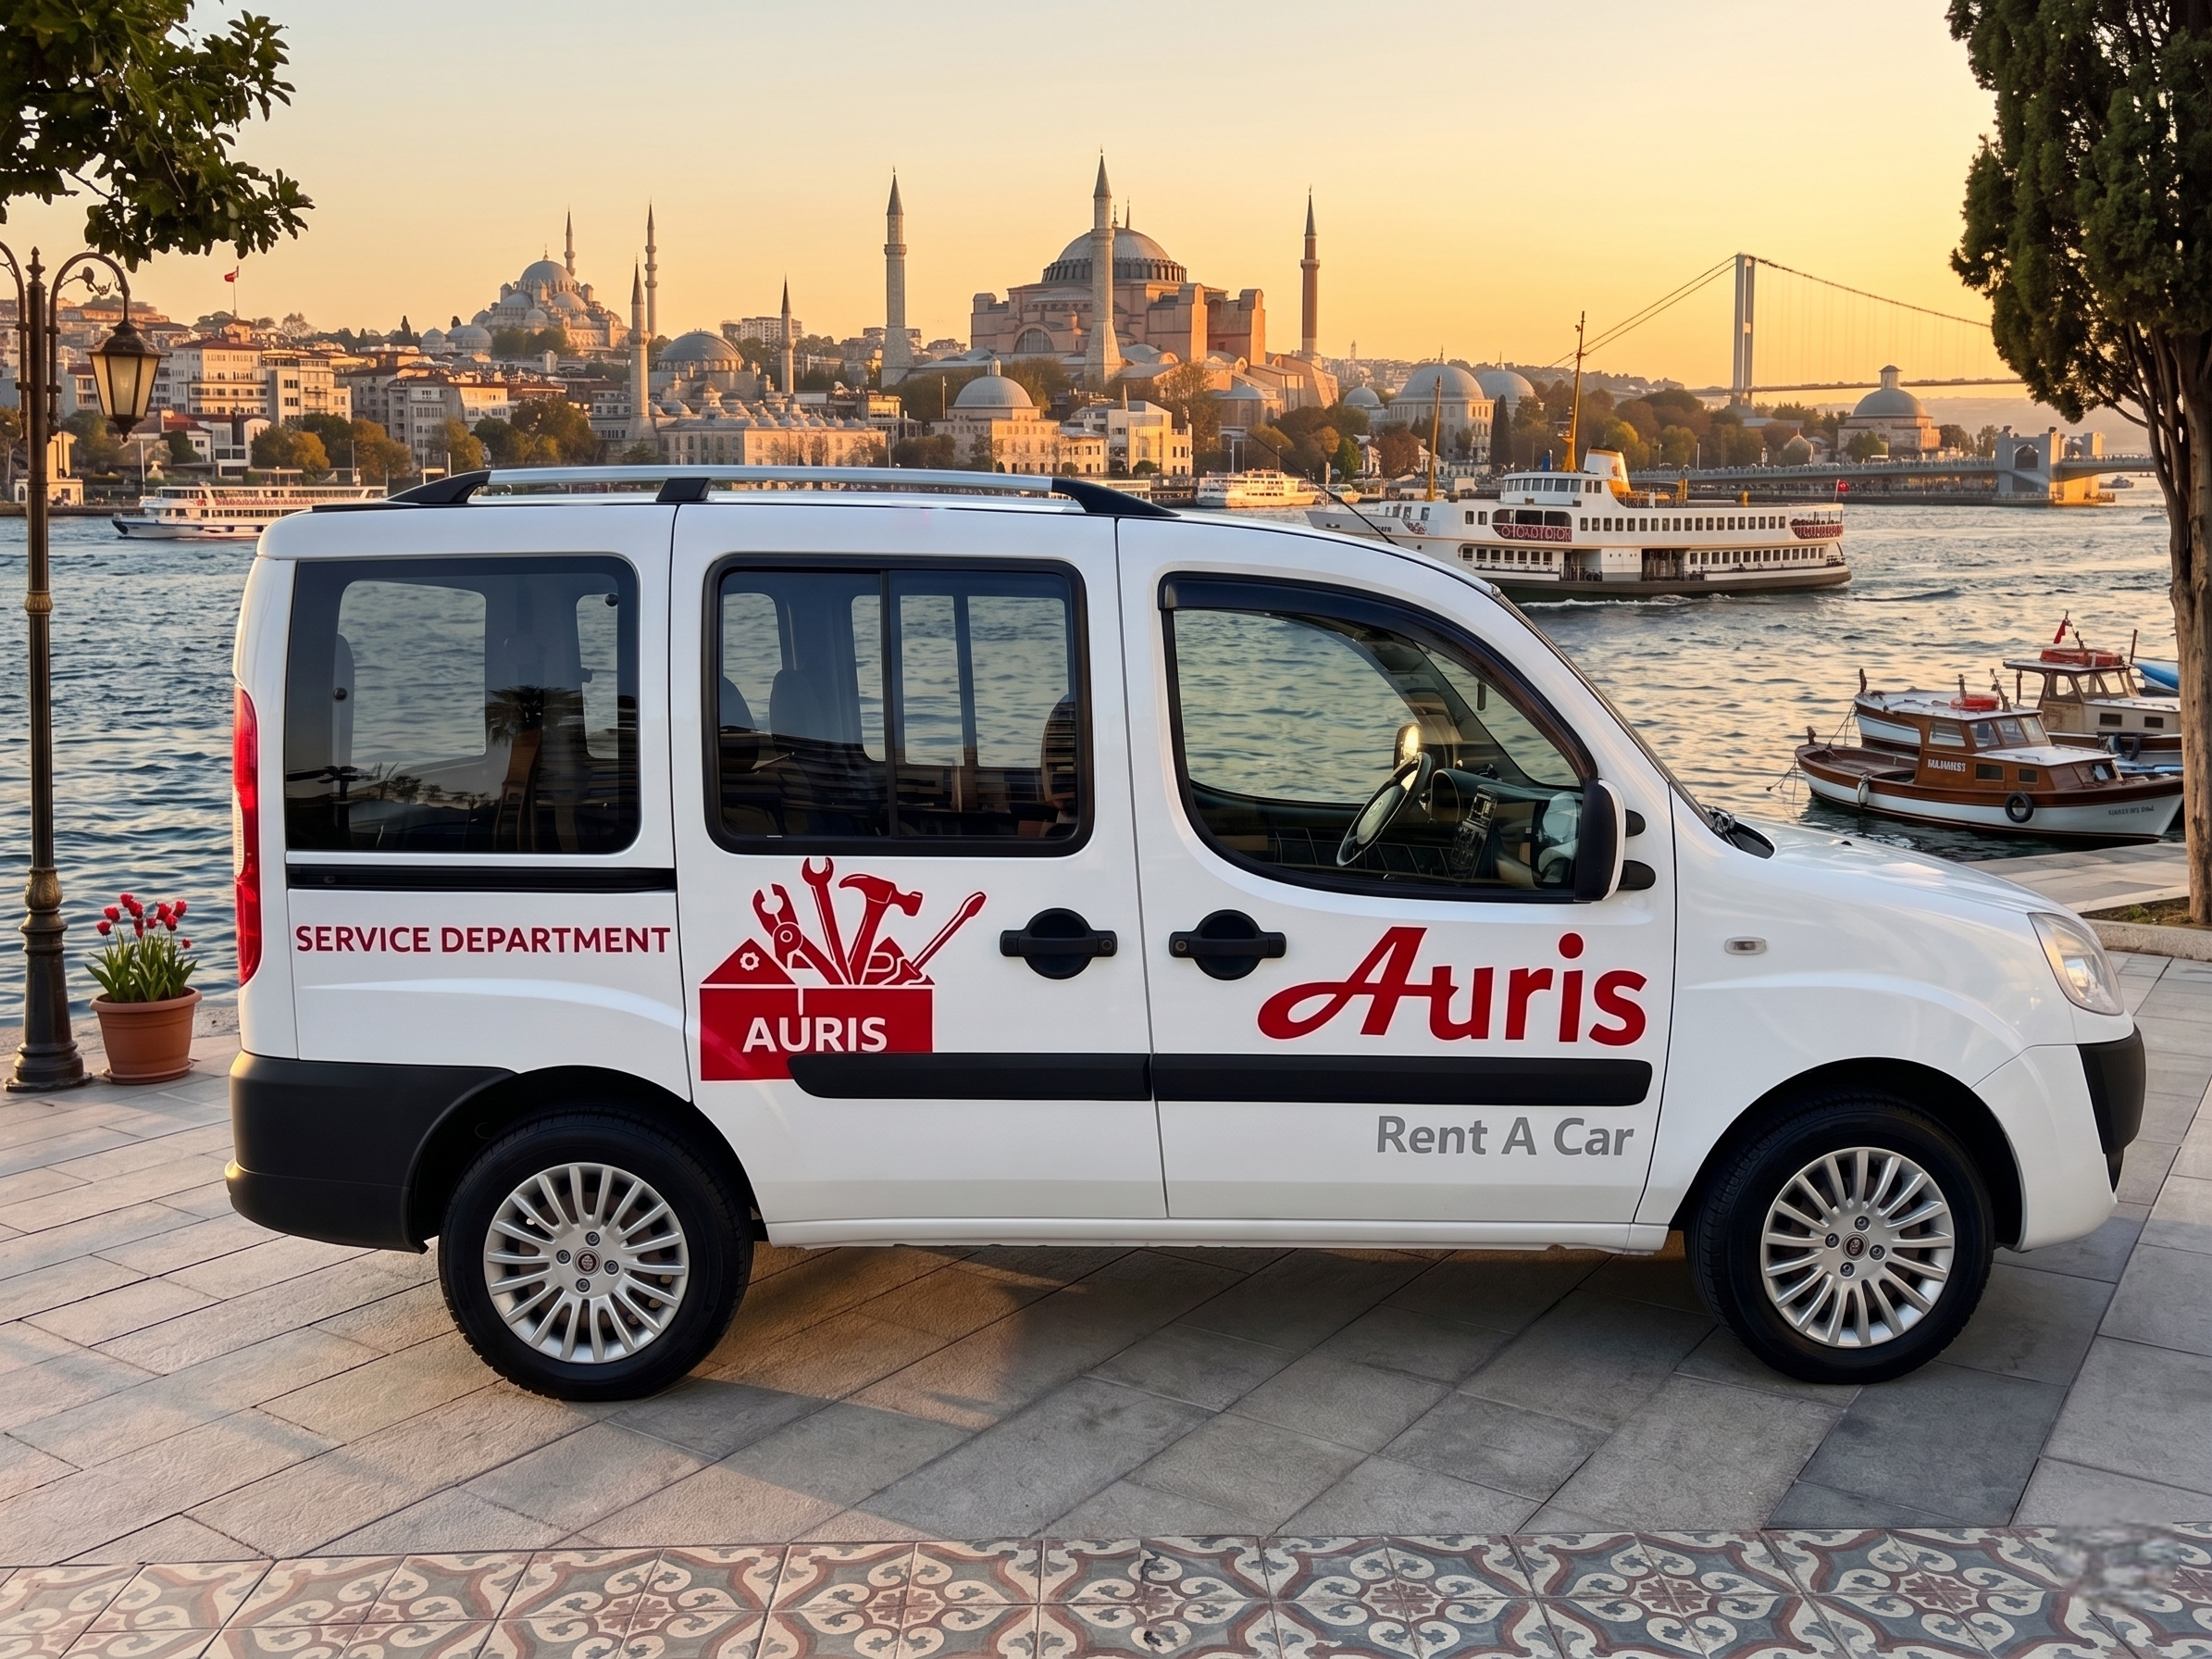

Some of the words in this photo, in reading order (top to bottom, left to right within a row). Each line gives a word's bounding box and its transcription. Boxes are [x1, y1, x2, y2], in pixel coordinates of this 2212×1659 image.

[295, 926, 431, 953] SERVICE
[441, 927, 671, 954] DEPARTMENT
[1257, 926, 1647, 1047] Auris
[742, 1017, 888, 1053] AURIS
[1377, 1116, 1488, 1155] Rent
[1501, 1116, 1537, 1156] A
[1553, 1117, 1635, 1156] Car
